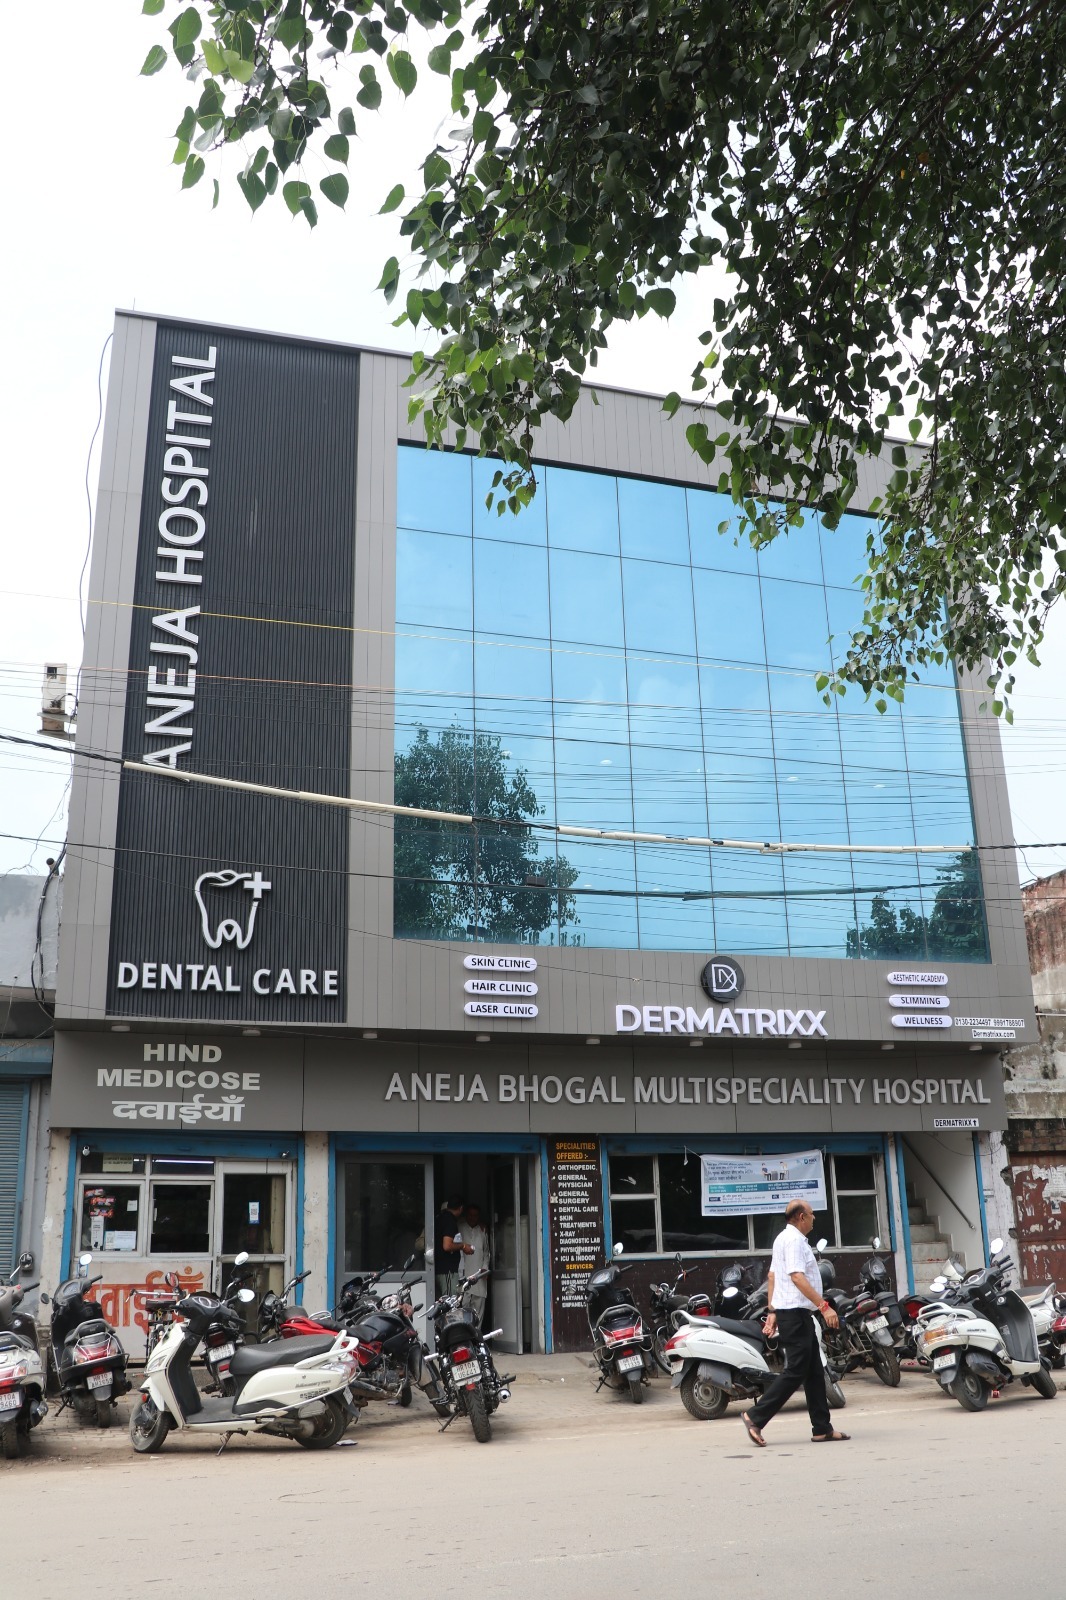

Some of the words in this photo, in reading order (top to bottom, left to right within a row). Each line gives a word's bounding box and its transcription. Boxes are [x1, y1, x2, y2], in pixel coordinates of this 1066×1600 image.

[156, 346, 217, 584] HOSPITAL
[142, 605, 201, 780] ANEJA
[471, 957, 495, 967] SKIN
[497, 958, 531, 968] CLINIC
[117, 962, 241, 992] DENTAL
[252, 968, 339, 995] CARE
[472, 982, 496, 991] HAIR
[499, 983, 532, 992] CLINIC
[893, 974, 919, 982] AESTHETIC
[921, 975, 945, 983] ACADEMY
[470, 1004, 498, 1013] LASER
[503, 1005, 533, 1015] CLINIC
[901, 997, 941, 1005] SLIMMING
[615, 1004, 828, 1036] DERMATRIXX
[904, 1017, 943, 1025] WELLNESS
[143, 1043, 222, 1063] HIND
[97, 1068, 261, 1091] MEDICOSE
[385, 1072, 489, 1102] ANEJA
[499, 1074, 626, 1104] BHOGAL
[633, 1076, 866, 1104] MULTISPECIALITY
[872, 1078, 992, 1104] HOSPITAL
[111, 1093, 246, 1124] दवाईयाँ
[556, 1152, 583, 1160] OFFERED
